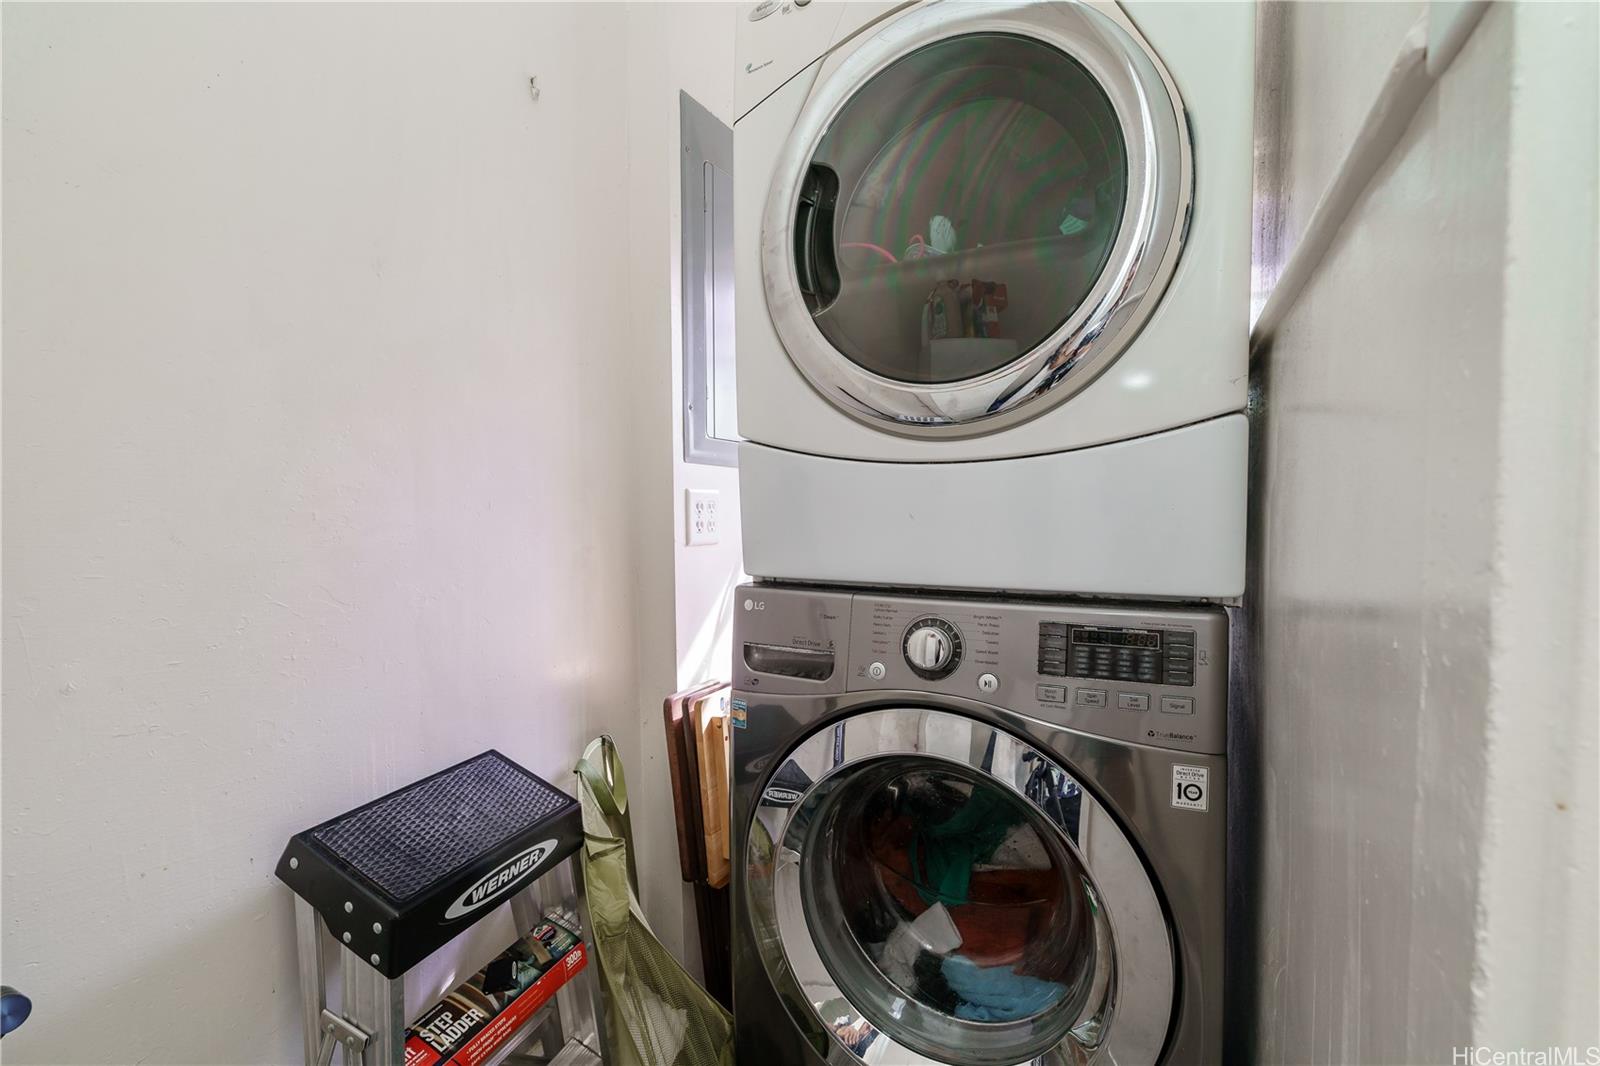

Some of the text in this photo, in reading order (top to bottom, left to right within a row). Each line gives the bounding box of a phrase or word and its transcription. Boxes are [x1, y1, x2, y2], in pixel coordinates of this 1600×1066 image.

[754, 601, 765, 610] LG
[792, 638, 807, 646] Direct
[1177, 782, 1203, 802] 10
[471, 849, 539, 904] WERNER
[419, 1011, 454, 1042] STEP
[430, 1008, 484, 1053] LADDER
